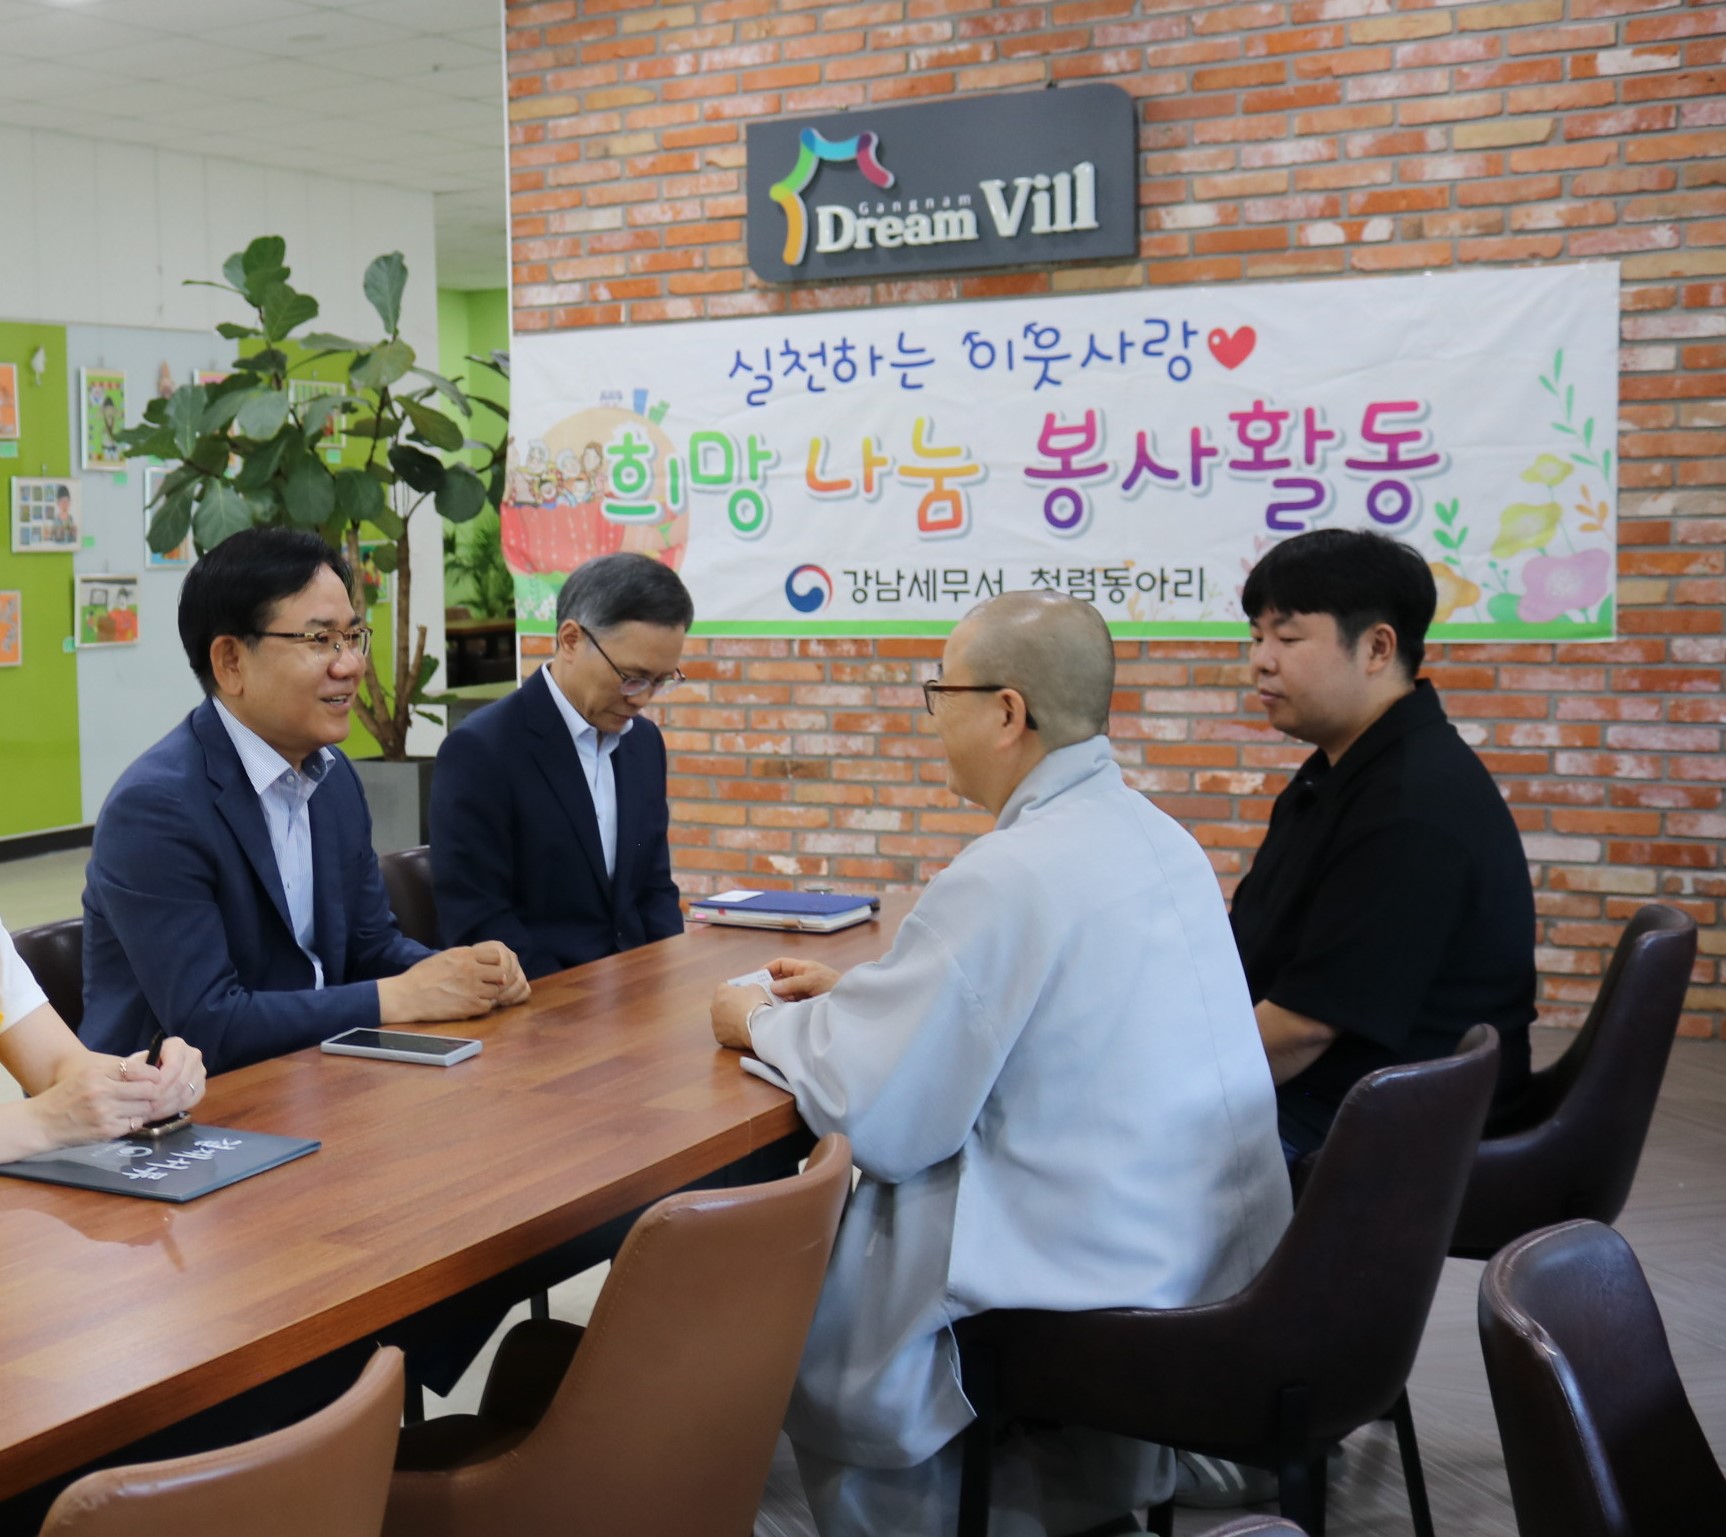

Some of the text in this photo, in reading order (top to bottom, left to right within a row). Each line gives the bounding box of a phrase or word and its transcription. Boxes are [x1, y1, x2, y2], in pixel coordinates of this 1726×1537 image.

[816, 161, 1099, 253] Dream Vill
[859, 193, 972, 215] Gangnam
[728, 318, 1199, 406] 실천하는 이웃사랑
[605, 400, 1440, 533] 희망 나눔 봉사활동
[843, 566, 1205, 604] 강남세무서 청렴동아리
